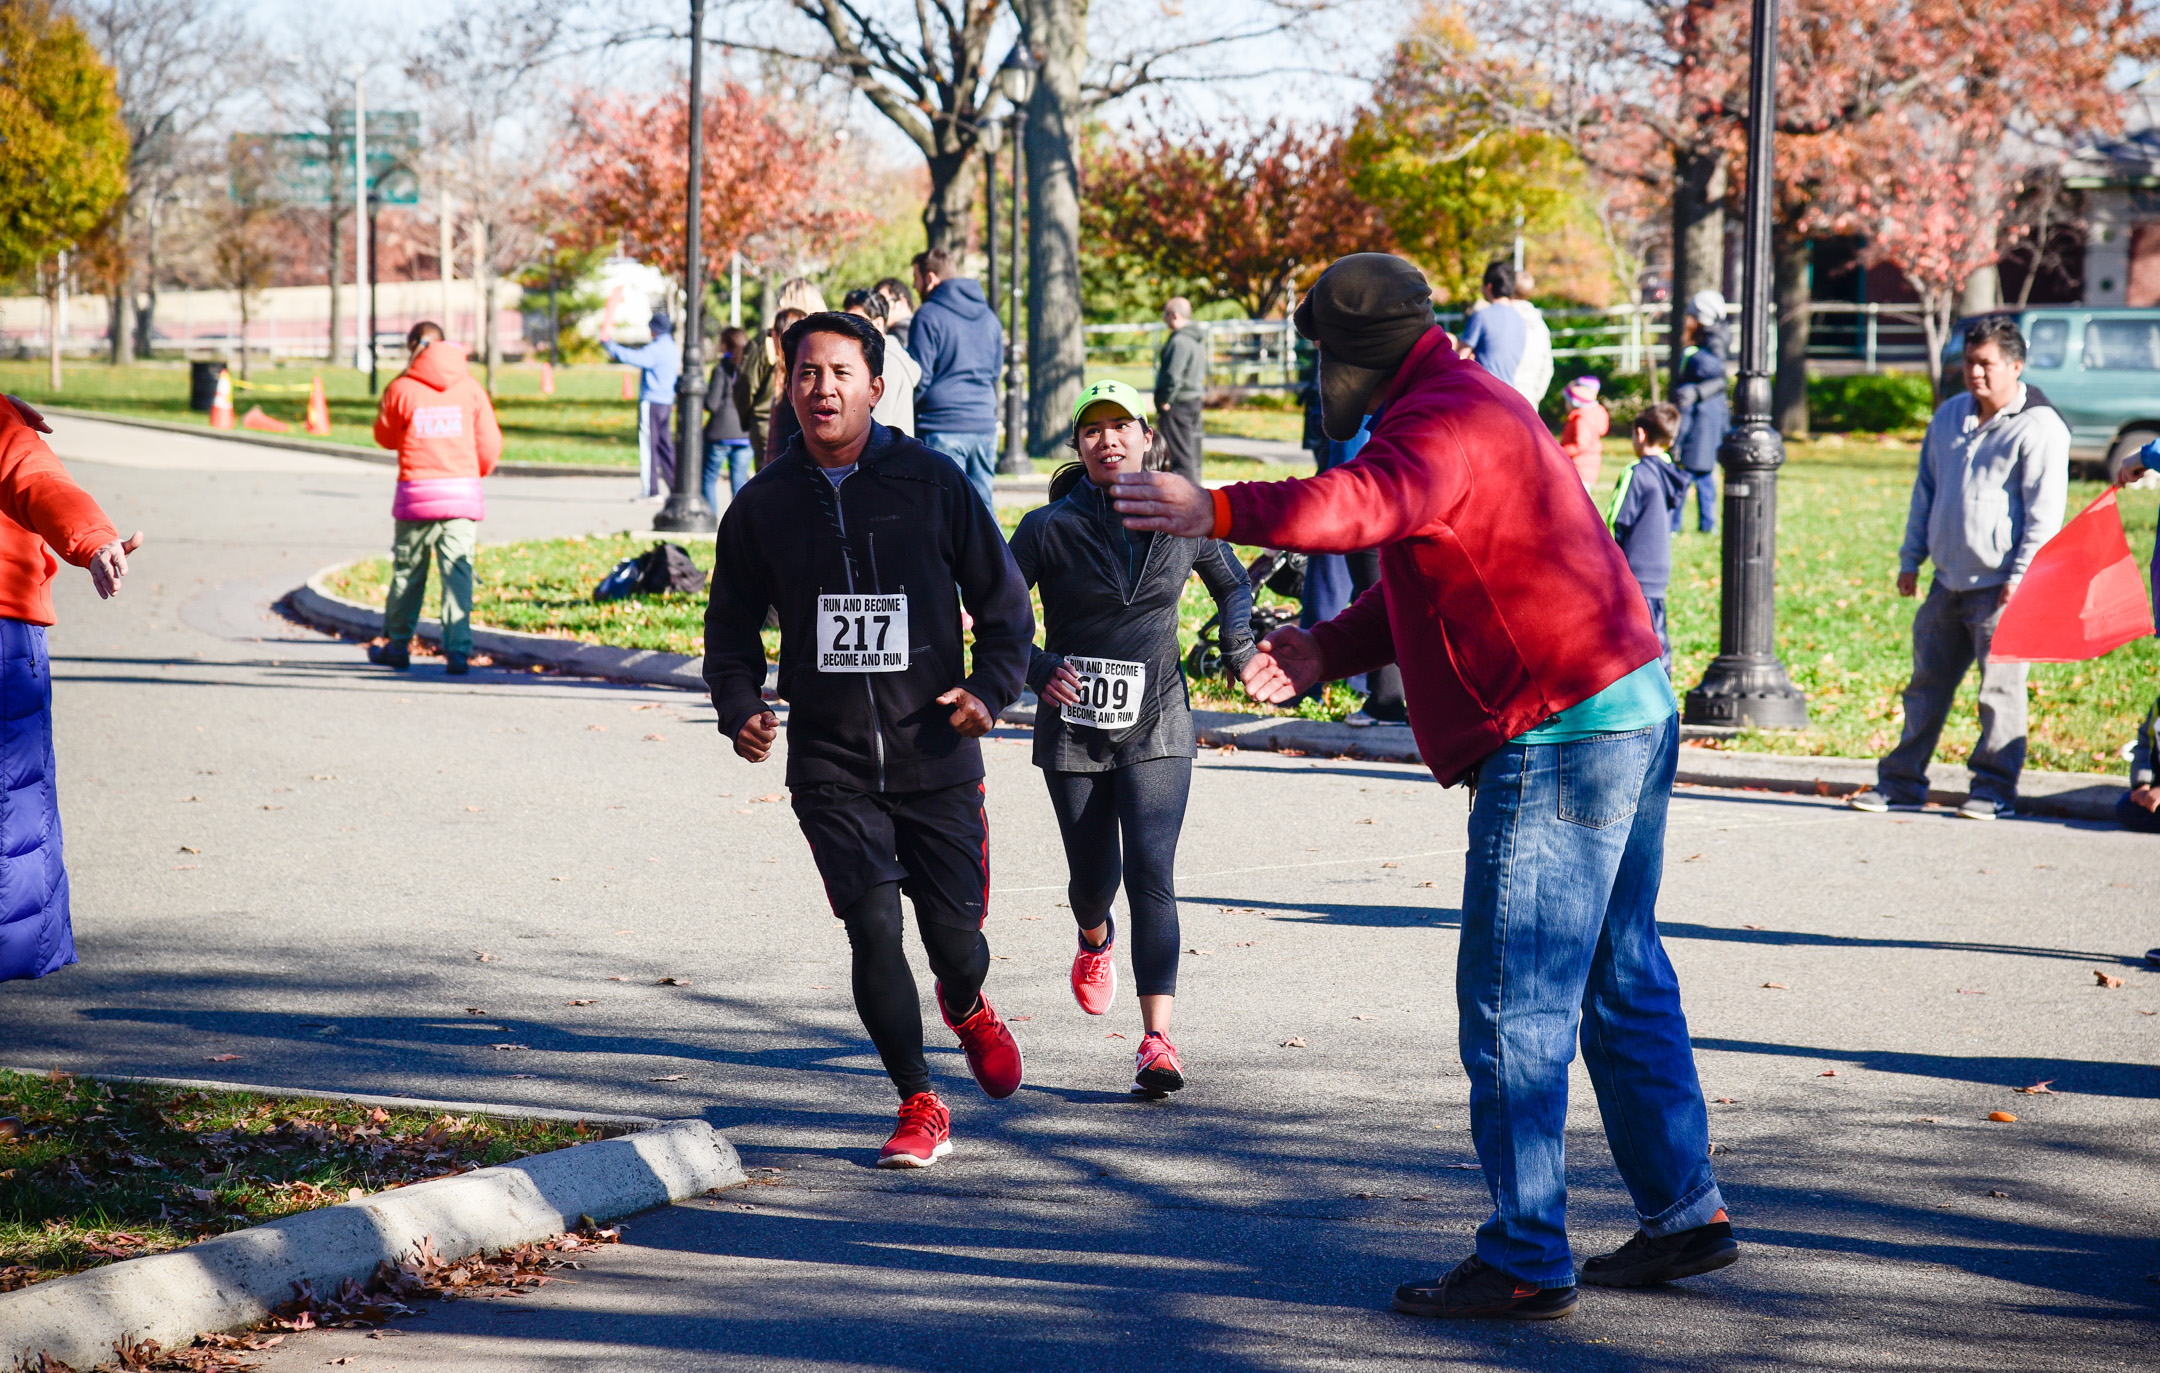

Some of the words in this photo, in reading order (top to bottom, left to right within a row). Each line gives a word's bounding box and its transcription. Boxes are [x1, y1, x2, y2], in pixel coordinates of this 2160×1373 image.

[415, 419, 462, 434] TEAM
[823, 599, 840, 612] RUN
[843, 599, 861, 612] AND
[864, 598, 900, 612] BECOME
[833, 615, 890, 651] 217
[823, 653, 858, 666] BECOME
[861, 653, 880, 666] AND
[883, 653, 901, 665] RUN
[1086, 661, 1102, 674] AND
[1105, 663, 1138, 677] BECOME
[1076, 675, 1128, 710] 609
[1067, 705, 1096, 722] BECOME
[1098, 712, 1115, 723] AND
[1117, 711, 1133, 723] RUN
